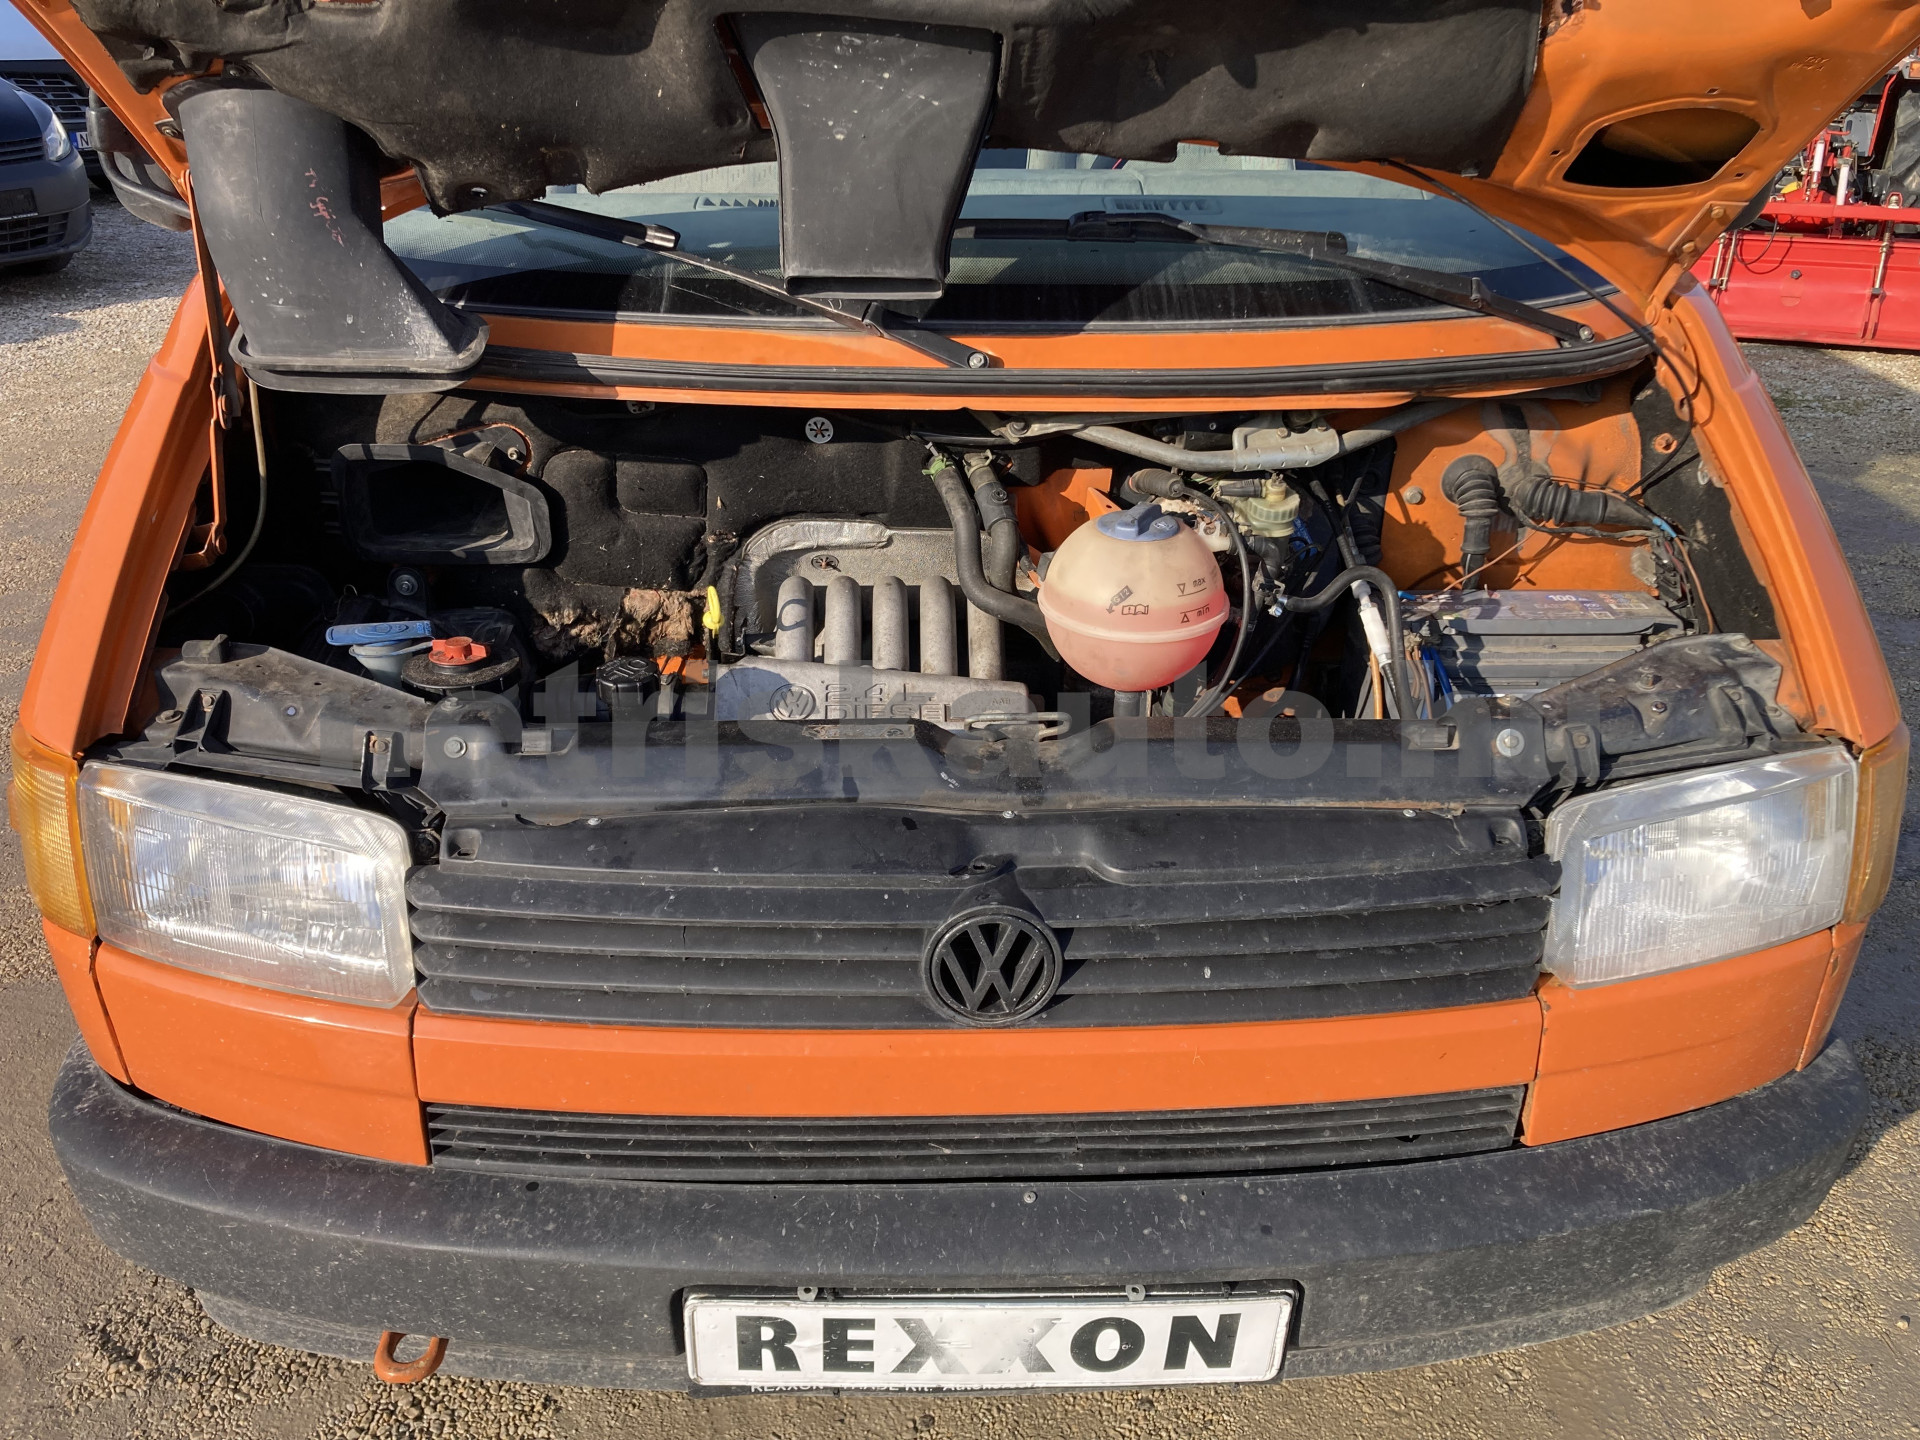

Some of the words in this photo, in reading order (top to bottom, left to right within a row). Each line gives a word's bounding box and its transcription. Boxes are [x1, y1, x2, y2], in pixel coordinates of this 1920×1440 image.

[1193, 577, 1206, 587] max
[1113, 588, 1130, 603] G12
[1196, 606, 1210, 617] min
[736, 1313, 1242, 1375] REXXON
